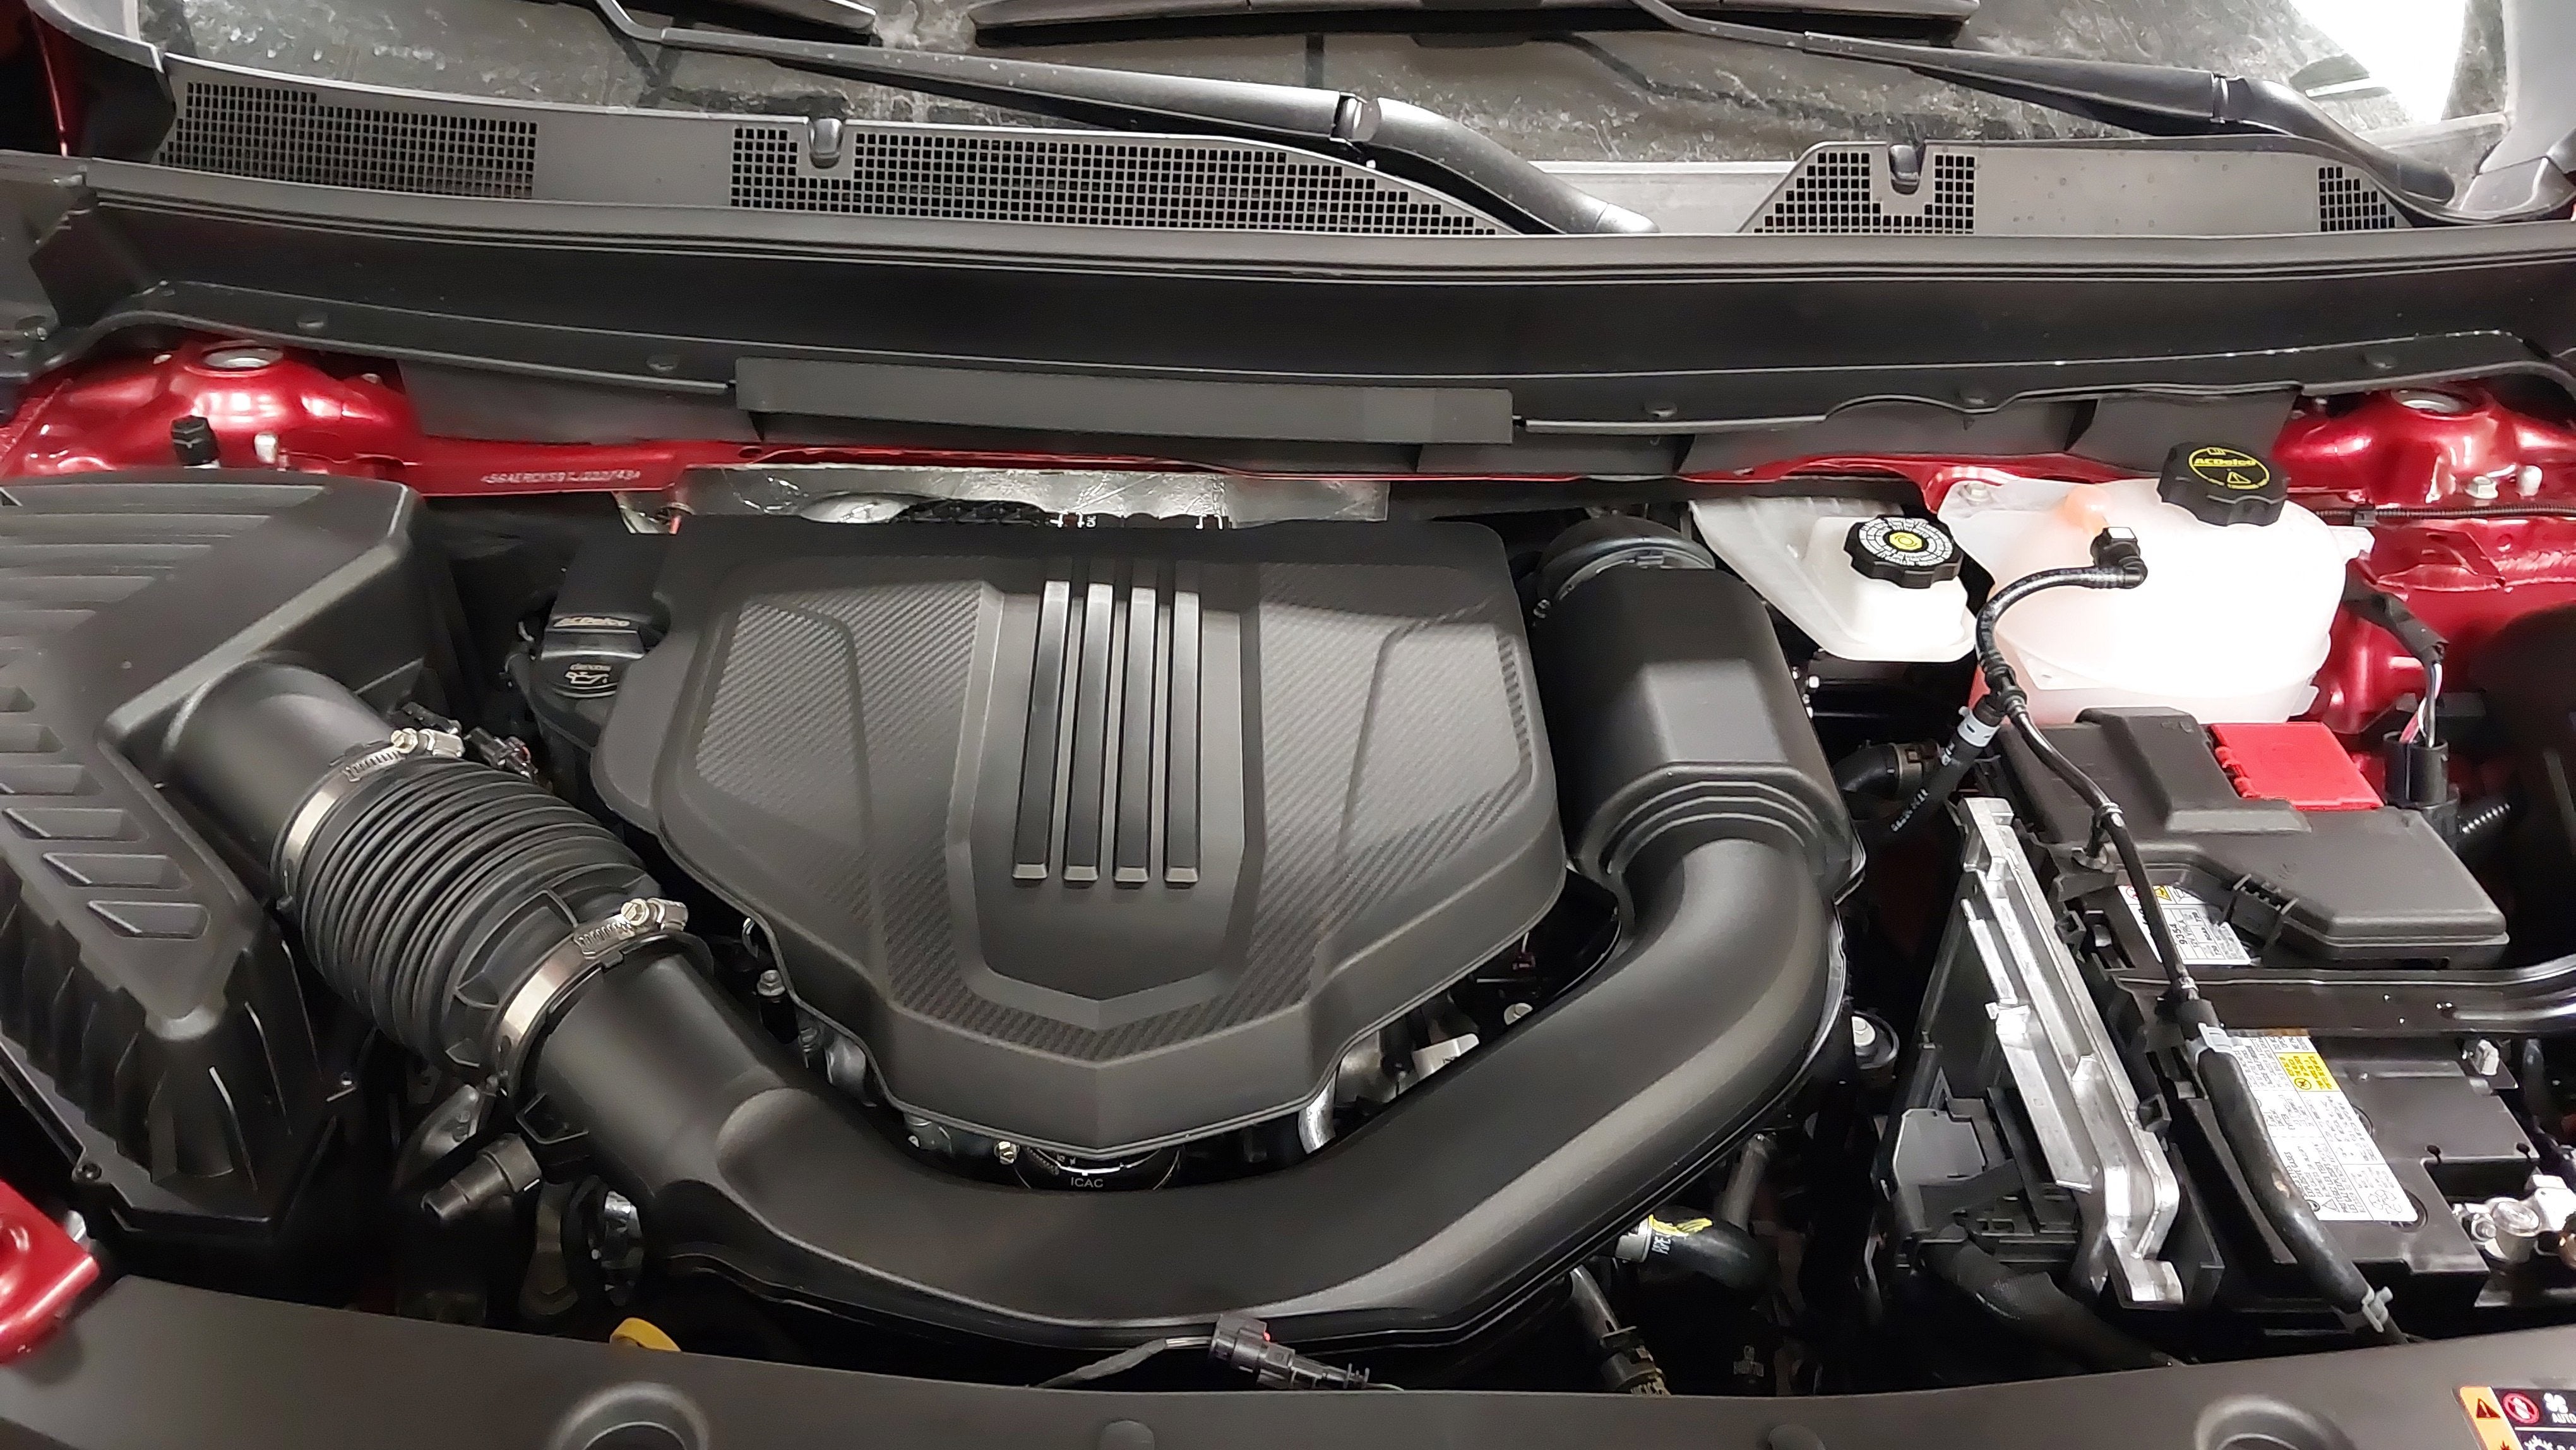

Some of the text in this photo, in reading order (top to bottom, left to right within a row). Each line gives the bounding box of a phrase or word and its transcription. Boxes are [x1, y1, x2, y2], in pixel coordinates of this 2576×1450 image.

[2194, 458, 2256, 466] ACDelco
[2168, 923, 2188, 944] 9354
[1070, 1177, 1104, 1188] ICAC
[2551, 1412, 2576, 1424] AUTO
